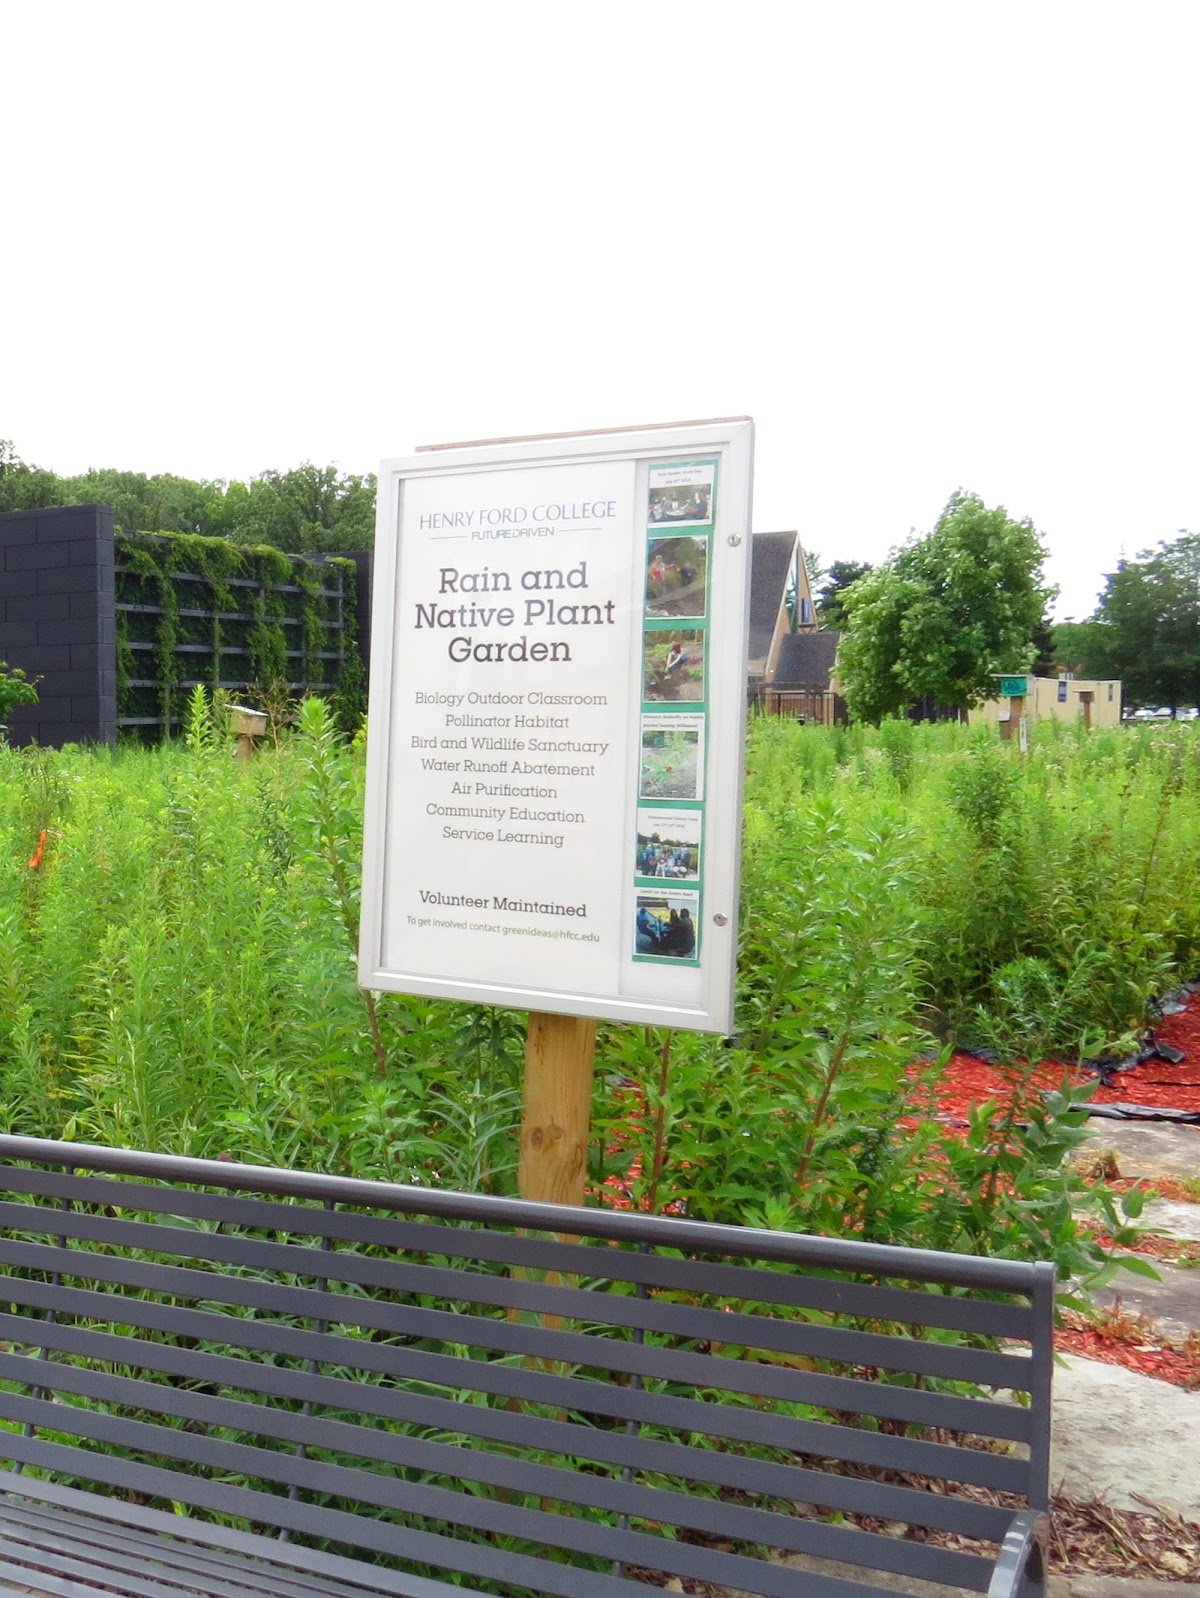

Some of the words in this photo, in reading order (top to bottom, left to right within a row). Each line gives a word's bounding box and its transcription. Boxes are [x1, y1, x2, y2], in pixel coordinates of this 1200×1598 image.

[419, 511, 475, 530] HENRY
[479, 507, 527, 525] FORD
[532, 501, 616, 522] COLLEGE
[439, 567, 512, 594] Rain
[521, 562, 588, 590] and
[414, 602, 514, 628] Native
[523, 599, 615, 626] Plant
[448, 636, 572, 663] Garden
[415, 692, 464, 707] Biology
[468, 693, 524, 705] Outdoor
[527, 693, 607, 706] Classroom
[445, 715, 510, 728] Pollinator
[515, 716, 569, 728] Habitat
[411, 736, 437, 749] Bird
[441, 737, 467, 749] and
[471, 738, 525, 750] Wildlife
[528, 739, 609, 756] Sanctuary
[421, 759, 460, 771] Water
[464, 760, 508, 773] Runoff
[511, 762, 595, 776] Abatement
[451, 782, 472, 795] Air
[475, 783, 558, 798] Purification
[426, 803, 505, 821] Community
[510, 808, 585, 823] Education
[443, 827, 493, 841] Service
[498, 830, 564, 848] Learning
[419, 890, 489, 909] Volunteer
[493, 897, 587, 918] Maintained
[406, 916, 417, 924] To
[418, 917, 431, 927] get
[433, 918, 467, 930] involved
[469, 923, 500, 933] contact
[502, 926, 600, 942] greenideas@hfcc.edu
